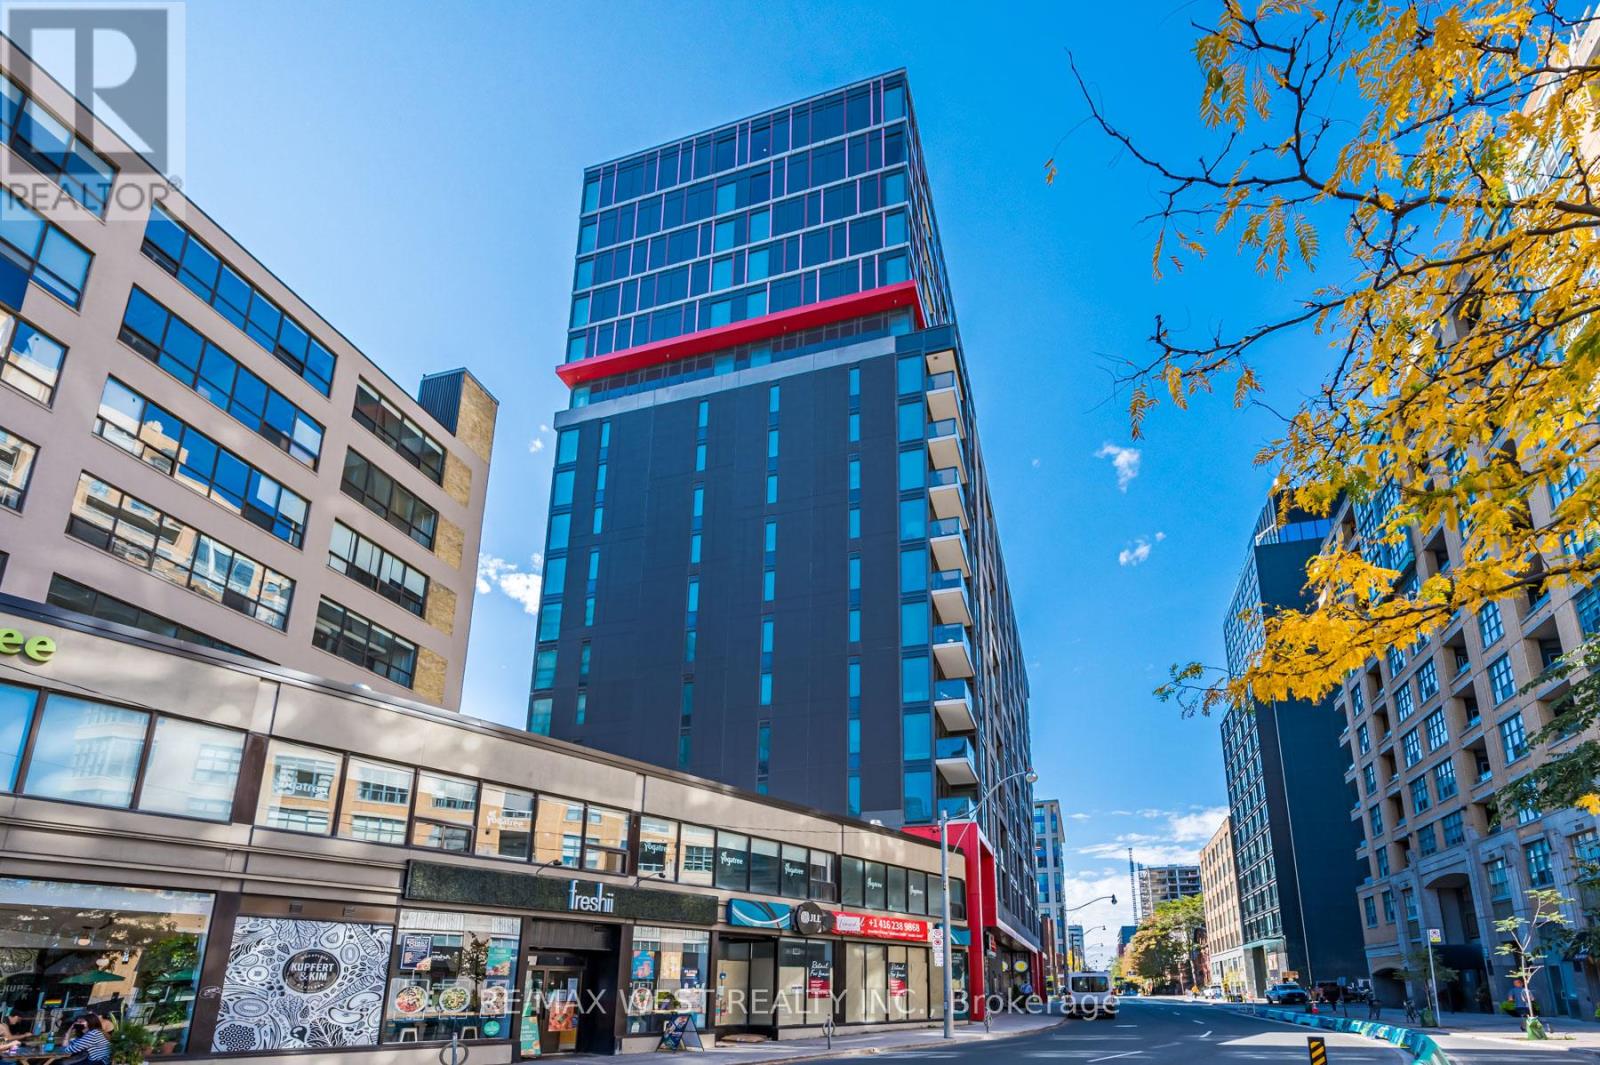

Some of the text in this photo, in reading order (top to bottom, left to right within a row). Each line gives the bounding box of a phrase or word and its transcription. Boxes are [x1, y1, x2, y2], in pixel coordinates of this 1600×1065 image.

[569, 880, 614, 912] freshii
[879, 919, 891, 930] 416
[290, 962, 335, 972] KUPFERT
[299, 971, 328, 981] & KIM
